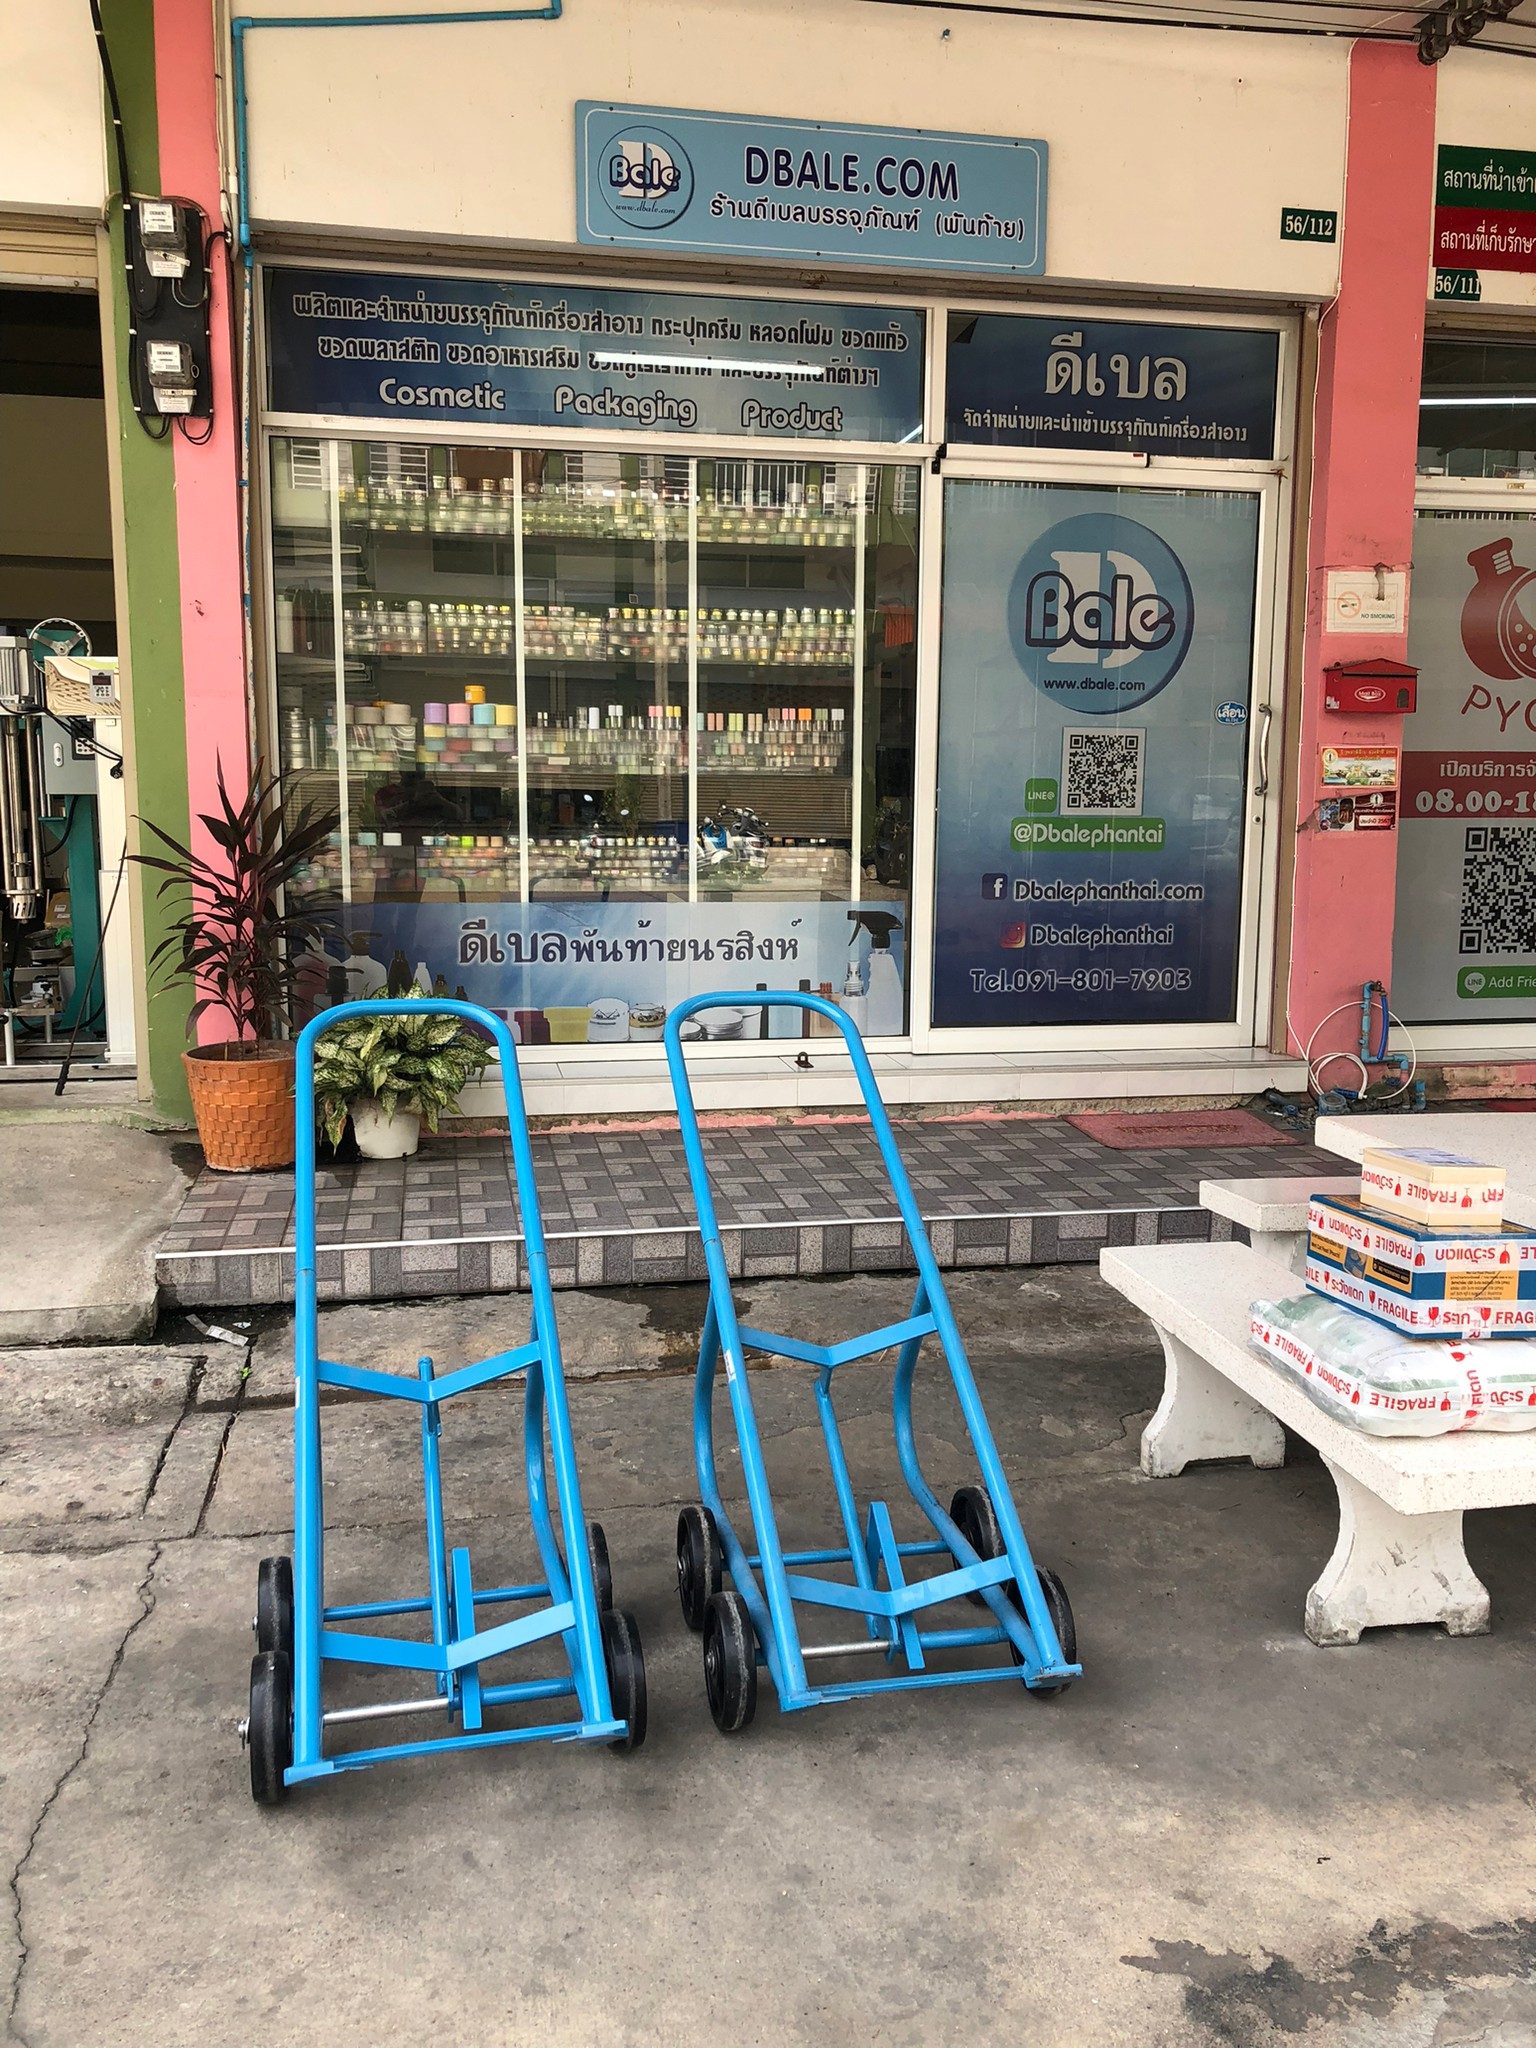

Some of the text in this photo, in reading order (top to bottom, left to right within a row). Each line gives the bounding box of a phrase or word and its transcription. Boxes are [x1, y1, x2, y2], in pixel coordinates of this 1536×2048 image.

[745, 145, 959, 202] DBALE.COM
[615, 201, 676, 215] www.dbale.com
[710, 192, 1025, 243] ร้านดีเบลบรรจุภัณฑ์ (พันท้าย)
[1285, 214, 1333, 236] 56/112
[1435, 275, 1481, 295] 56/111
[652, 316, 741, 346] กระปุกครีม
[749, 319, 833, 348] หลอดโฟม
[841, 321, 908, 352] ขวดแก้ว
[318, 335, 440, 363] ขวดพลาสติก
[447, 342, 580, 370] ขวดอาหารเสริม
[1044, 331, 1188, 401] ดีเบล
[379, 377, 843, 432] Cosmetic Packaging Product
[1044, 677, 1145, 691] www.dbale.com
[1415, 786, 1536, 813] 08.00-1
[1013, 823, 1163, 848] @Dbalephantai
[1014, 879, 1204, 906] Dbalephanthai.com
[458, 918, 803, 964] ดีเบลพันท้ายนรสิงห์
[1030, 923, 1174, 950] Dbalephanthai
[970, 967, 1191, 993] Tel.091-801-7903
[1467, 978, 1483, 986] LINE
[1488, 976, 1513, 988] Add
[1407, 1183, 1457, 1203] FRAGILE
[1375, 1235, 1413, 1260] FRAGILE
[1435, 1247, 1496, 1263] ระวังแตก
[1378, 1298, 1418, 1324] FRAGILE
[1275, 1334, 1308, 1365] FRAGILE
[1369, 1392, 1437, 1411] FRAGILE
